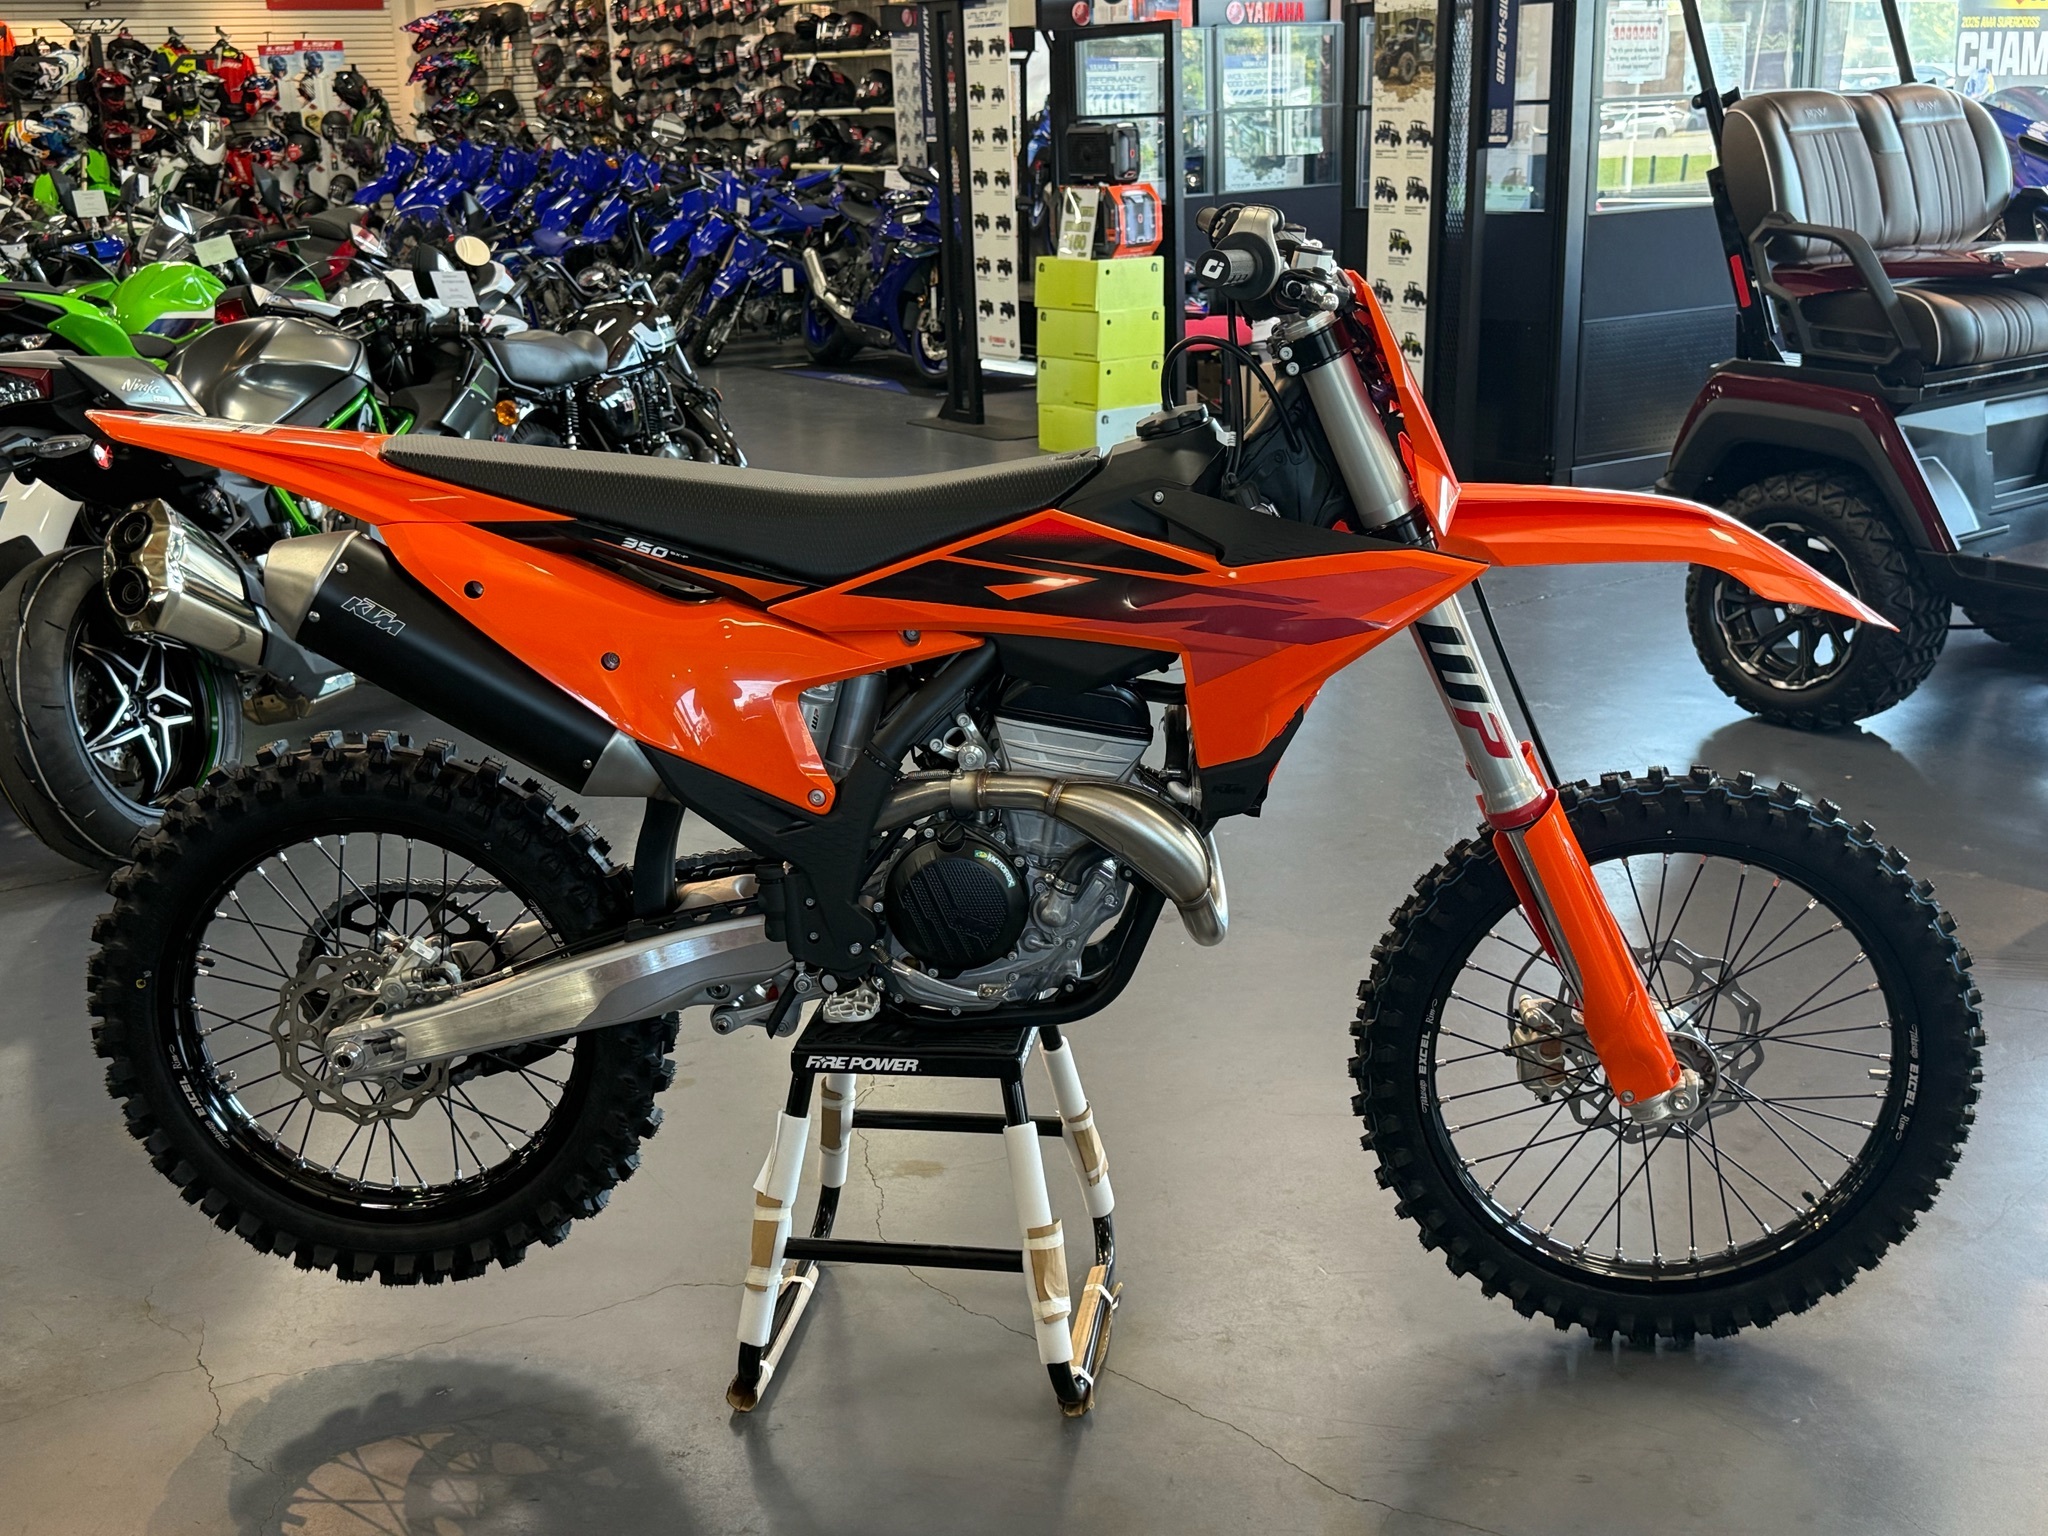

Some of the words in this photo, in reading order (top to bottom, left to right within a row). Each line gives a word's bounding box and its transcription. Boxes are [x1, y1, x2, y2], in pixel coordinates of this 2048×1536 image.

[922, 6, 930, 28] ATV
[1245, 2, 1305, 23] YAMAHA
[1997, 15, 2040, 28] SUPERCROSS
[923, 29, 932, 68] UTILITY
[121, 378, 160, 396] Ninja
[621, 537, 669, 558] 350
[341, 596, 406, 636] KTM
[987, 852, 1016, 888] MOTOREX
[805, 1055, 850, 1070] FIRE
[848, 1056, 920, 1072] POWER
[1418, 1031, 1431, 1075] EXCEL
[179, 1075, 207, 1117] EXCEL
[1904, 1063, 1920, 1108] EXCEL
